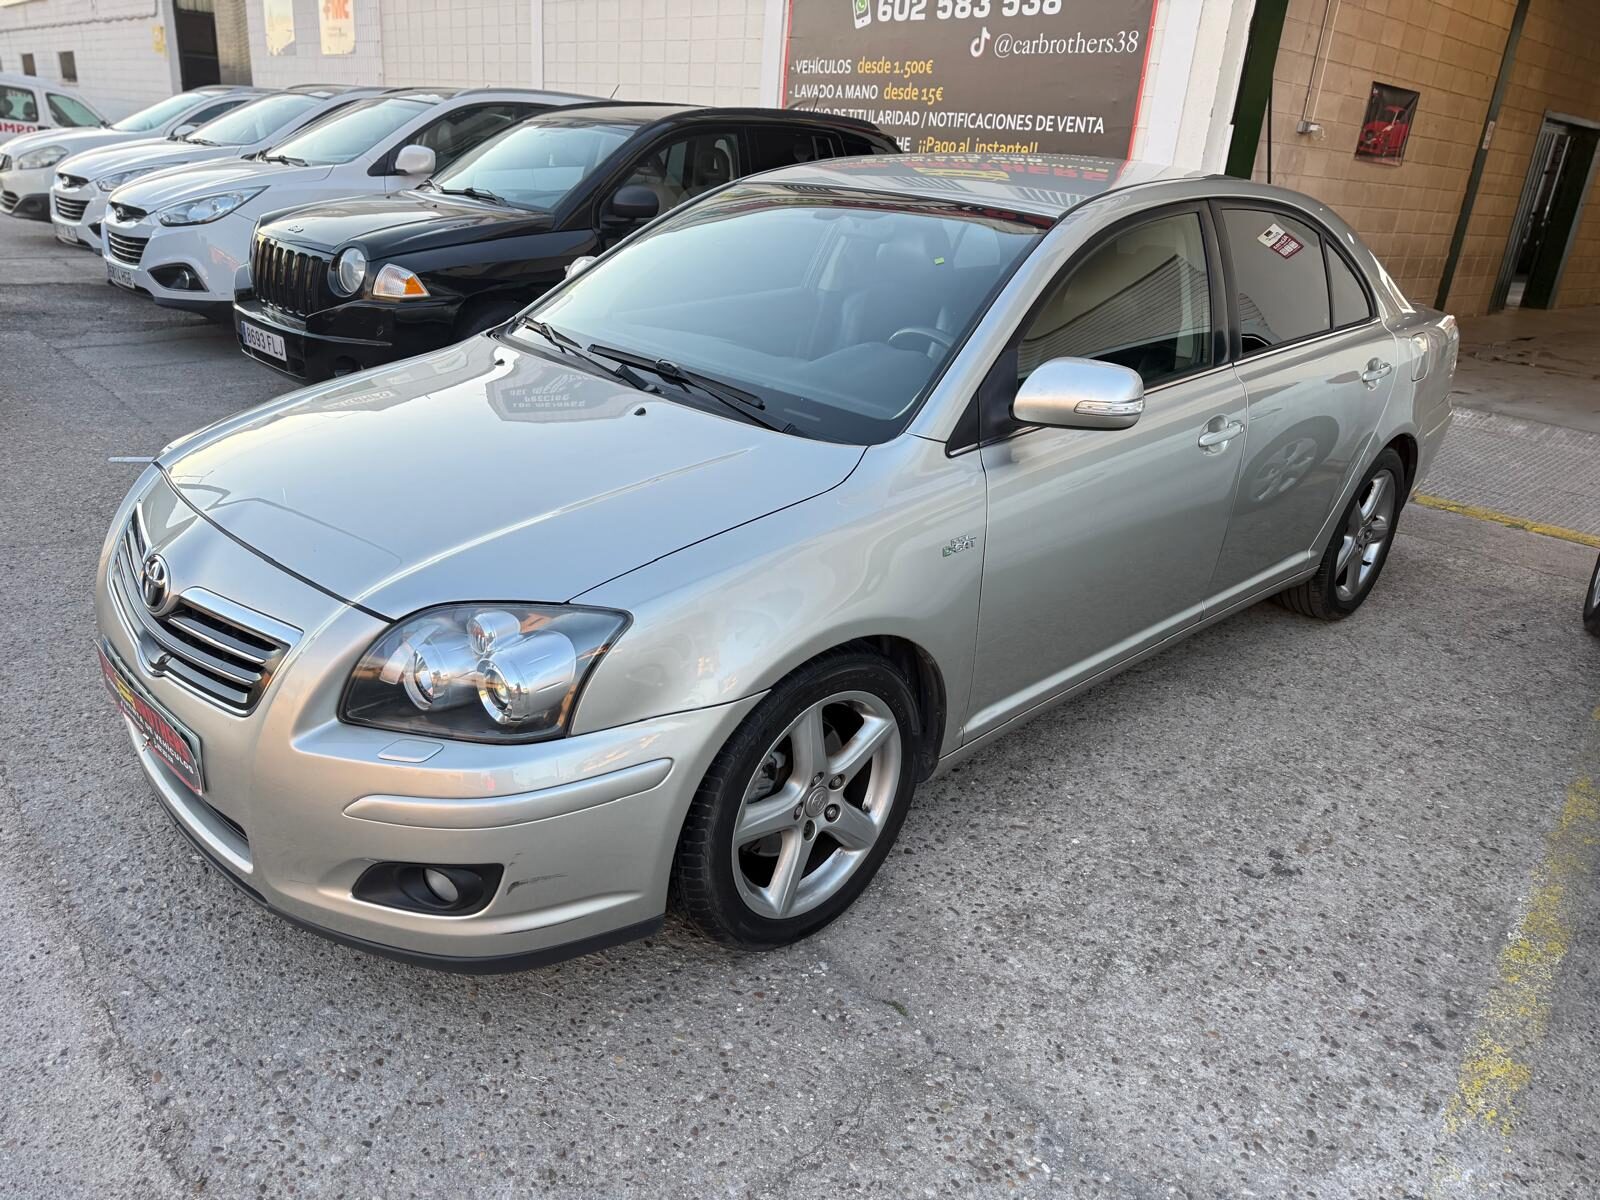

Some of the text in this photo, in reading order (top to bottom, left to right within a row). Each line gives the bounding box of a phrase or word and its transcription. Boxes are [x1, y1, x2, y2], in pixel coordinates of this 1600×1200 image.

[877, 0, 927, 22] 602
[936, 0, 991, 20] 583
[994, 30, 1140, 58] @carbrothers38
[857, 56, 891, 74] desde
[893, 59, 934, 78] 1.500€
[794, 84, 834, 99] LAVADO
[835, 85, 843, 99] A
[845, 85, 879, 100] MANO
[883, 82, 919, 101] desde
[921, 87, 944, 105] 15€
[848, 109, 920, 126] TITULARIDAD
[928, 111, 1033, 131] NOTIFICACIONES
[1035, 115, 1054, 132] DE
[1057, 116, 1105, 134] VENTA
[958, 137, 970, 153] al
[266, 335, 284, 356] FLJ
